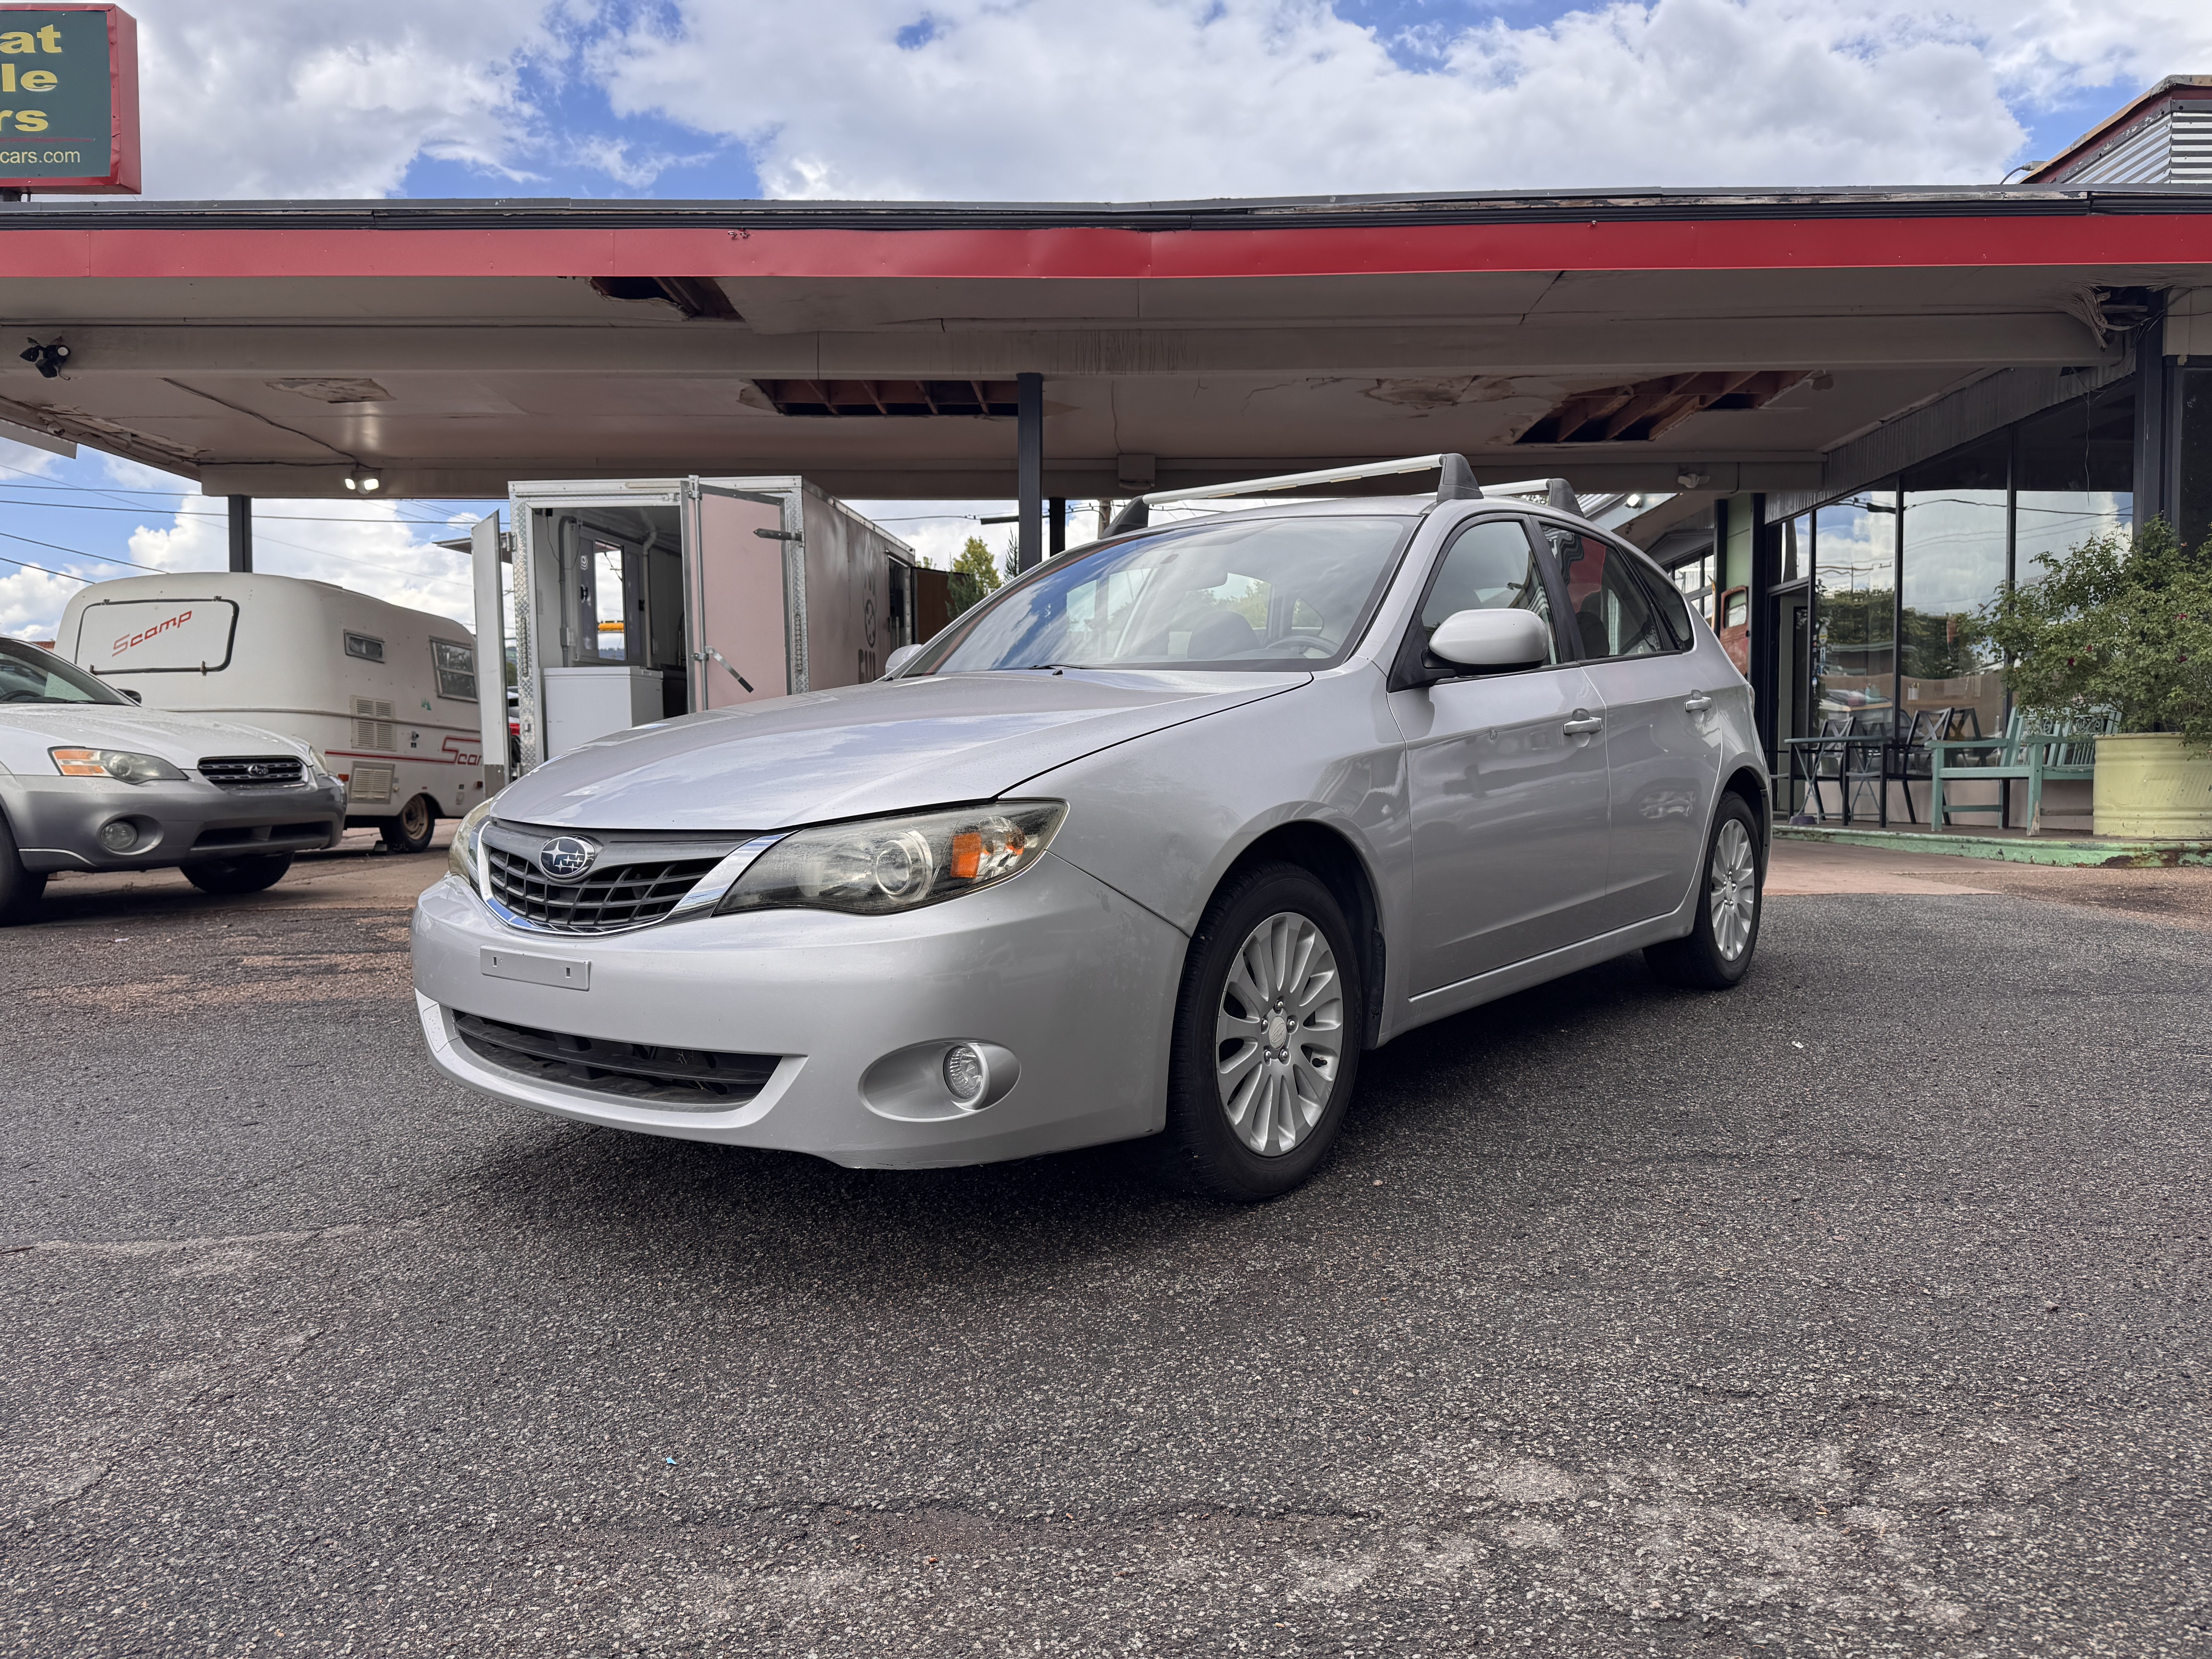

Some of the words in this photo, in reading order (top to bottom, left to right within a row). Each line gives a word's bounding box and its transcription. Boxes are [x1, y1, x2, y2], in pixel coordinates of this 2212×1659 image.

[0, 24, 62, 54] at
[1, 64, 58, 92] le
[0, 151, 80, 163] cars.com
[112, 610, 192, 657] Scamp
